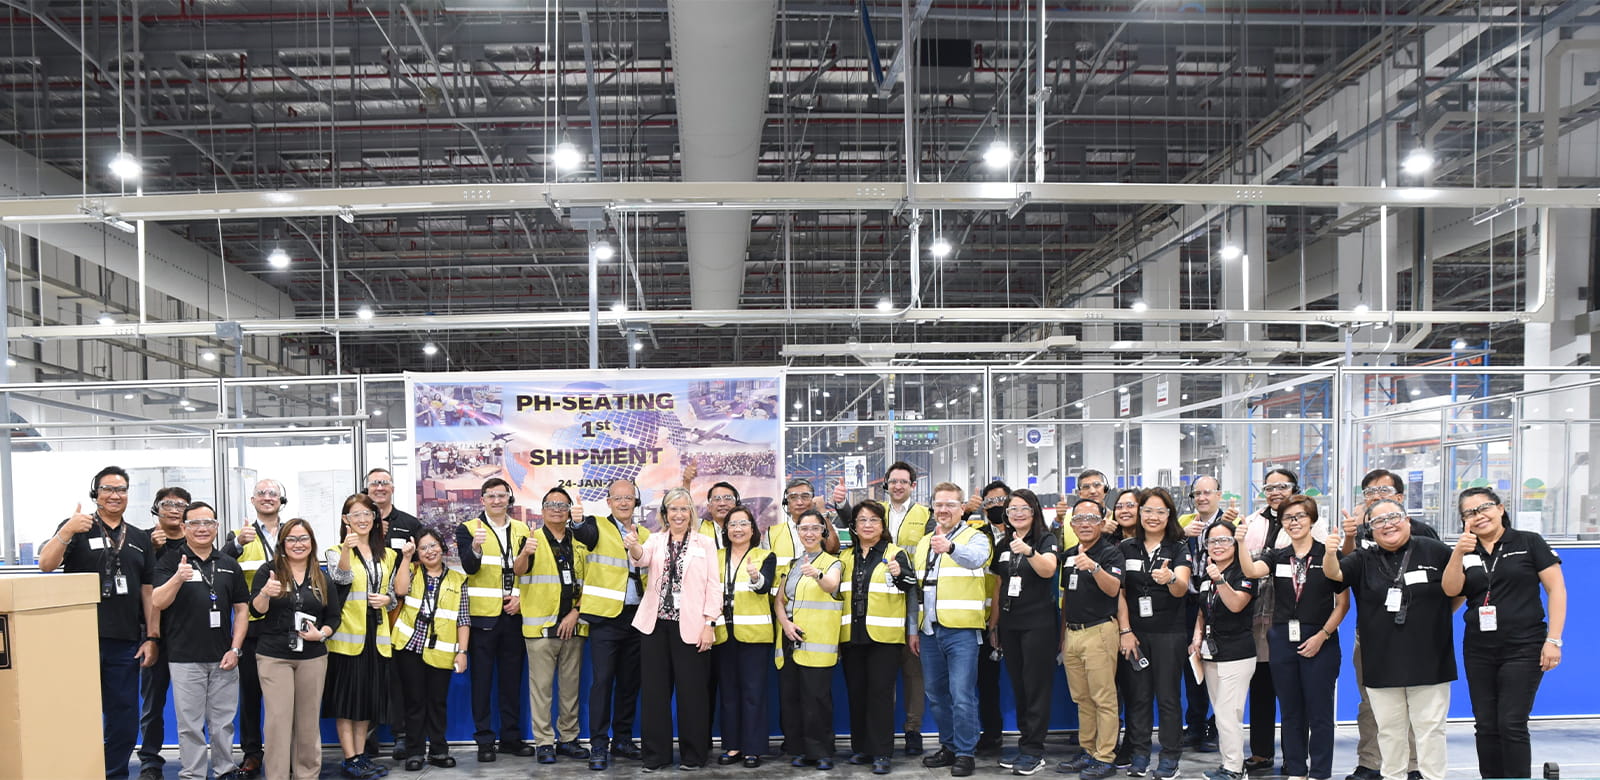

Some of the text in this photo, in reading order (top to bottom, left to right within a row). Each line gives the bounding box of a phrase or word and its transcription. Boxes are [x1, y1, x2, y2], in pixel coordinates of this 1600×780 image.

[516, 393, 674, 411] PH-SEATING
[581, 419, 610, 437] 1st
[529, 447, 663, 465] SHIPMENT
